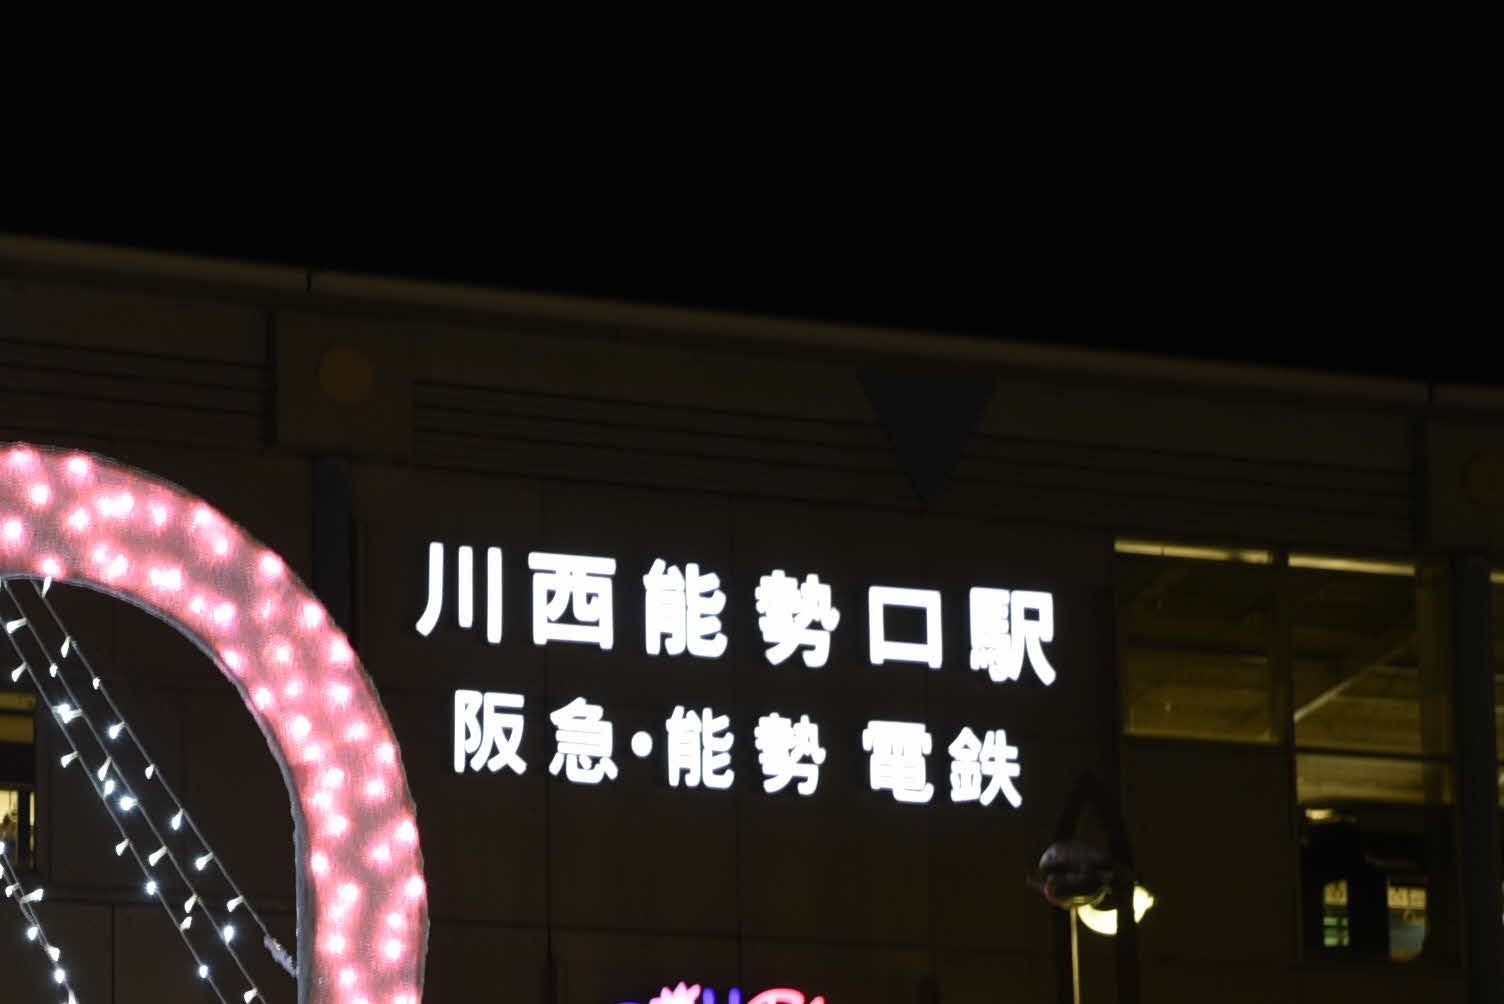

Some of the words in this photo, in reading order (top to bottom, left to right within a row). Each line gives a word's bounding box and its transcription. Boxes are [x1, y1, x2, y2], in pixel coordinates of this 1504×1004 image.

[415, 541, 1056, 686] 川西能勢口駅
